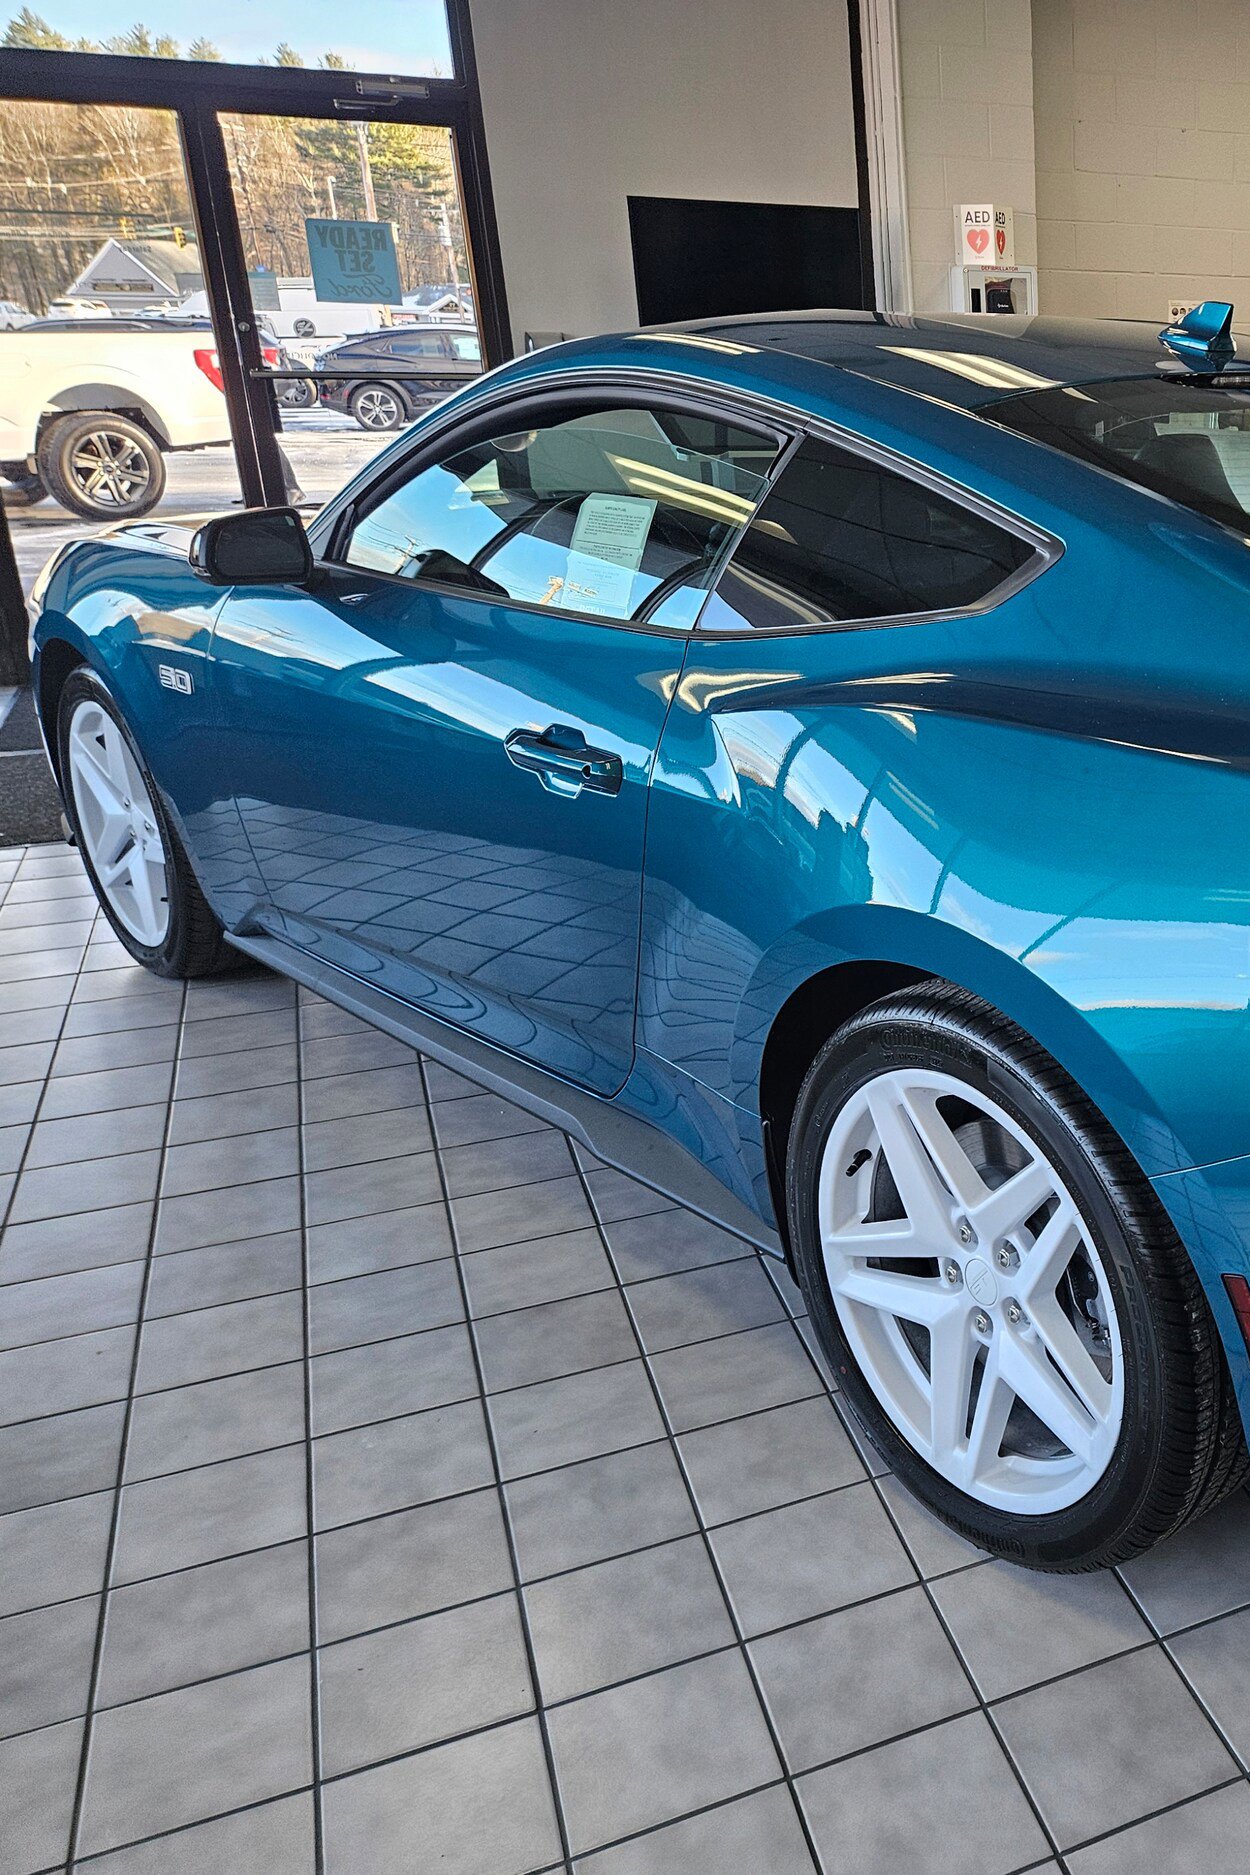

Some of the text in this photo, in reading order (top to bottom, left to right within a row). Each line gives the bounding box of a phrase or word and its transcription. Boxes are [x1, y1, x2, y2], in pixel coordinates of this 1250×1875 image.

[964, 211, 991, 224] AED
[994, 211, 1006, 225] AED
[158, 663, 192, 695] 5.0
